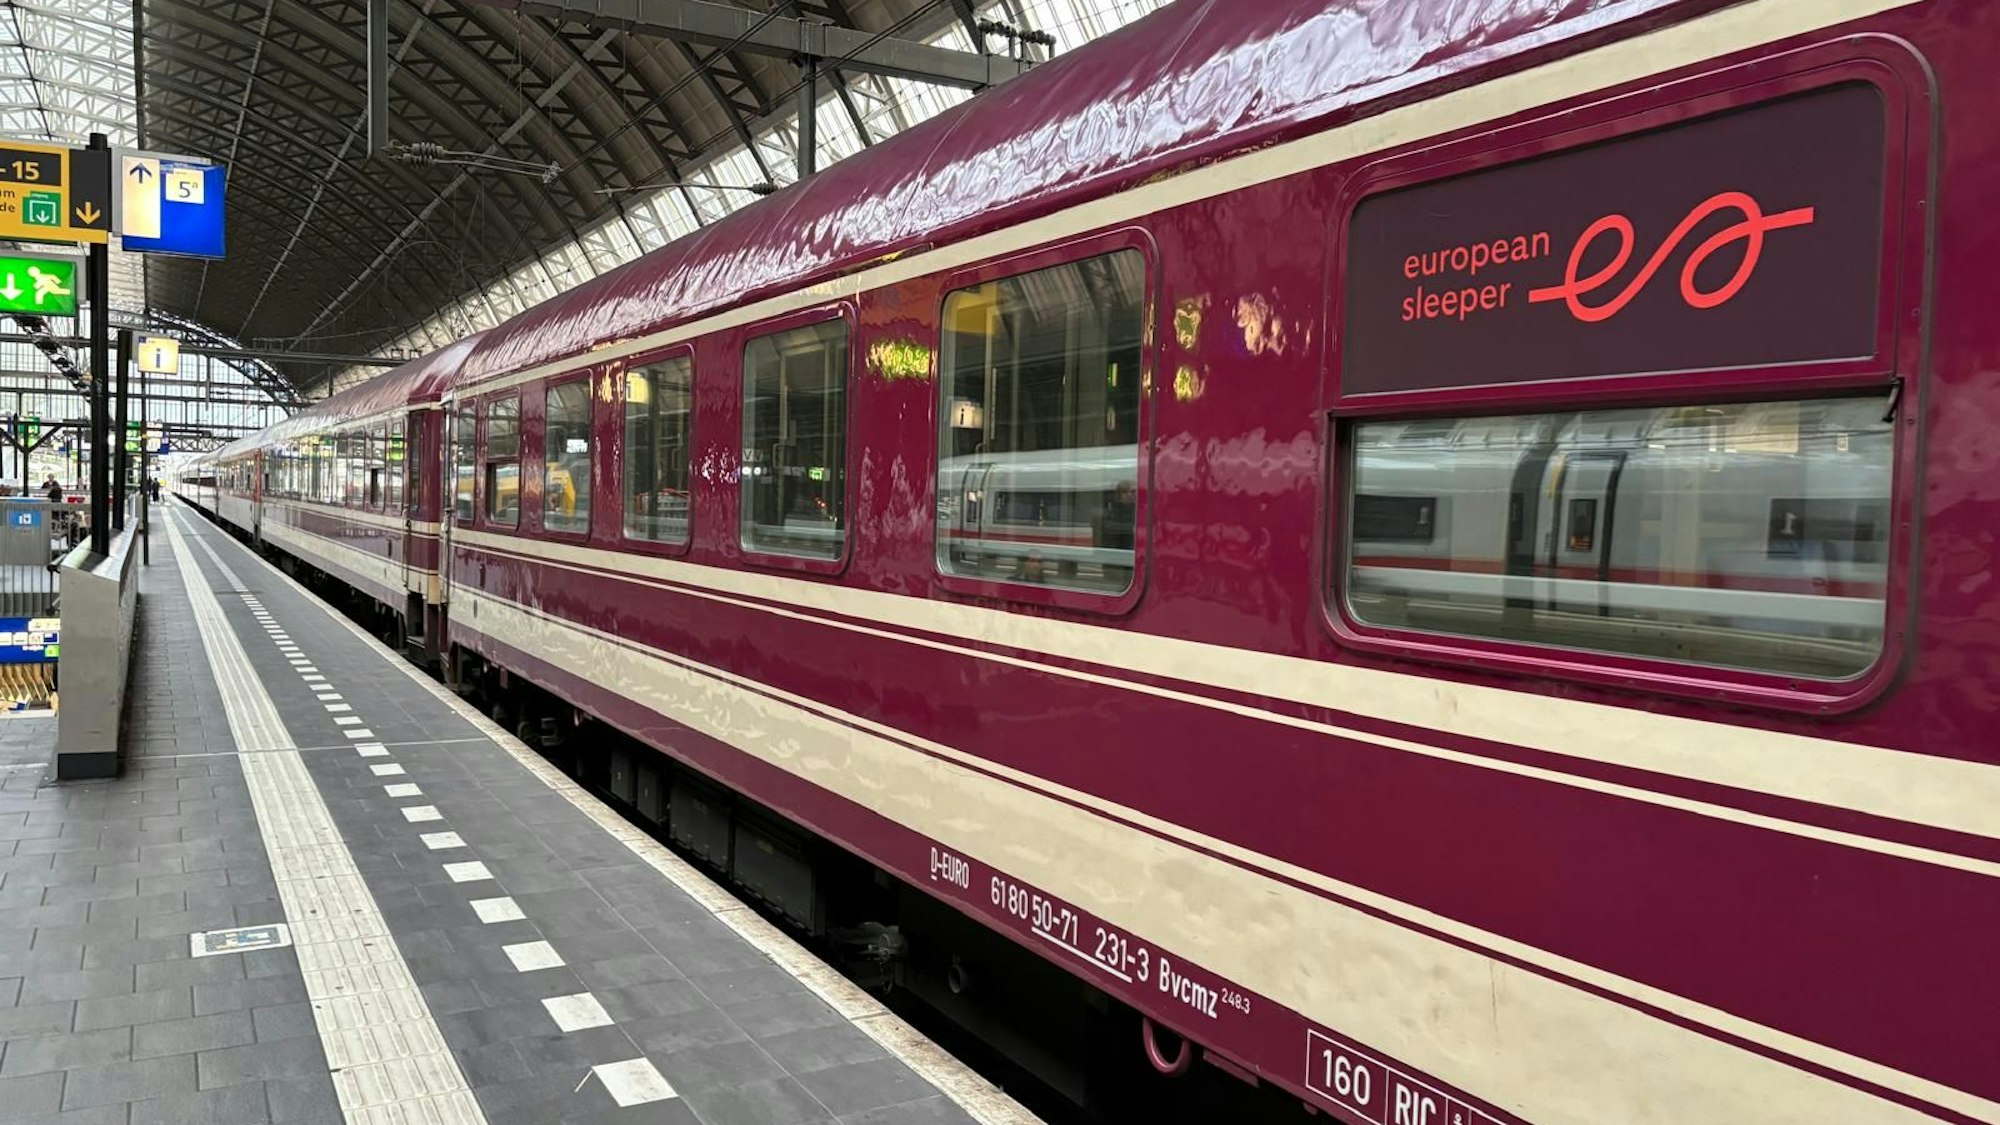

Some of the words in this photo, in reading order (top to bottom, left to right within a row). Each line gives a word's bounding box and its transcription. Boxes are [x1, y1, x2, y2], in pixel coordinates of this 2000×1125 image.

[12, 160, 40, 180] 15
[1403, 231, 1550, 279] european
[1402, 282, 1511, 321] sleeper
[930, 846, 970, 889] D-EURO
[1095, 927, 1150, 982] 231-3
[1159, 957, 1218, 1019] Bvcmz
[1322, 1049, 1371, 1106] 160
